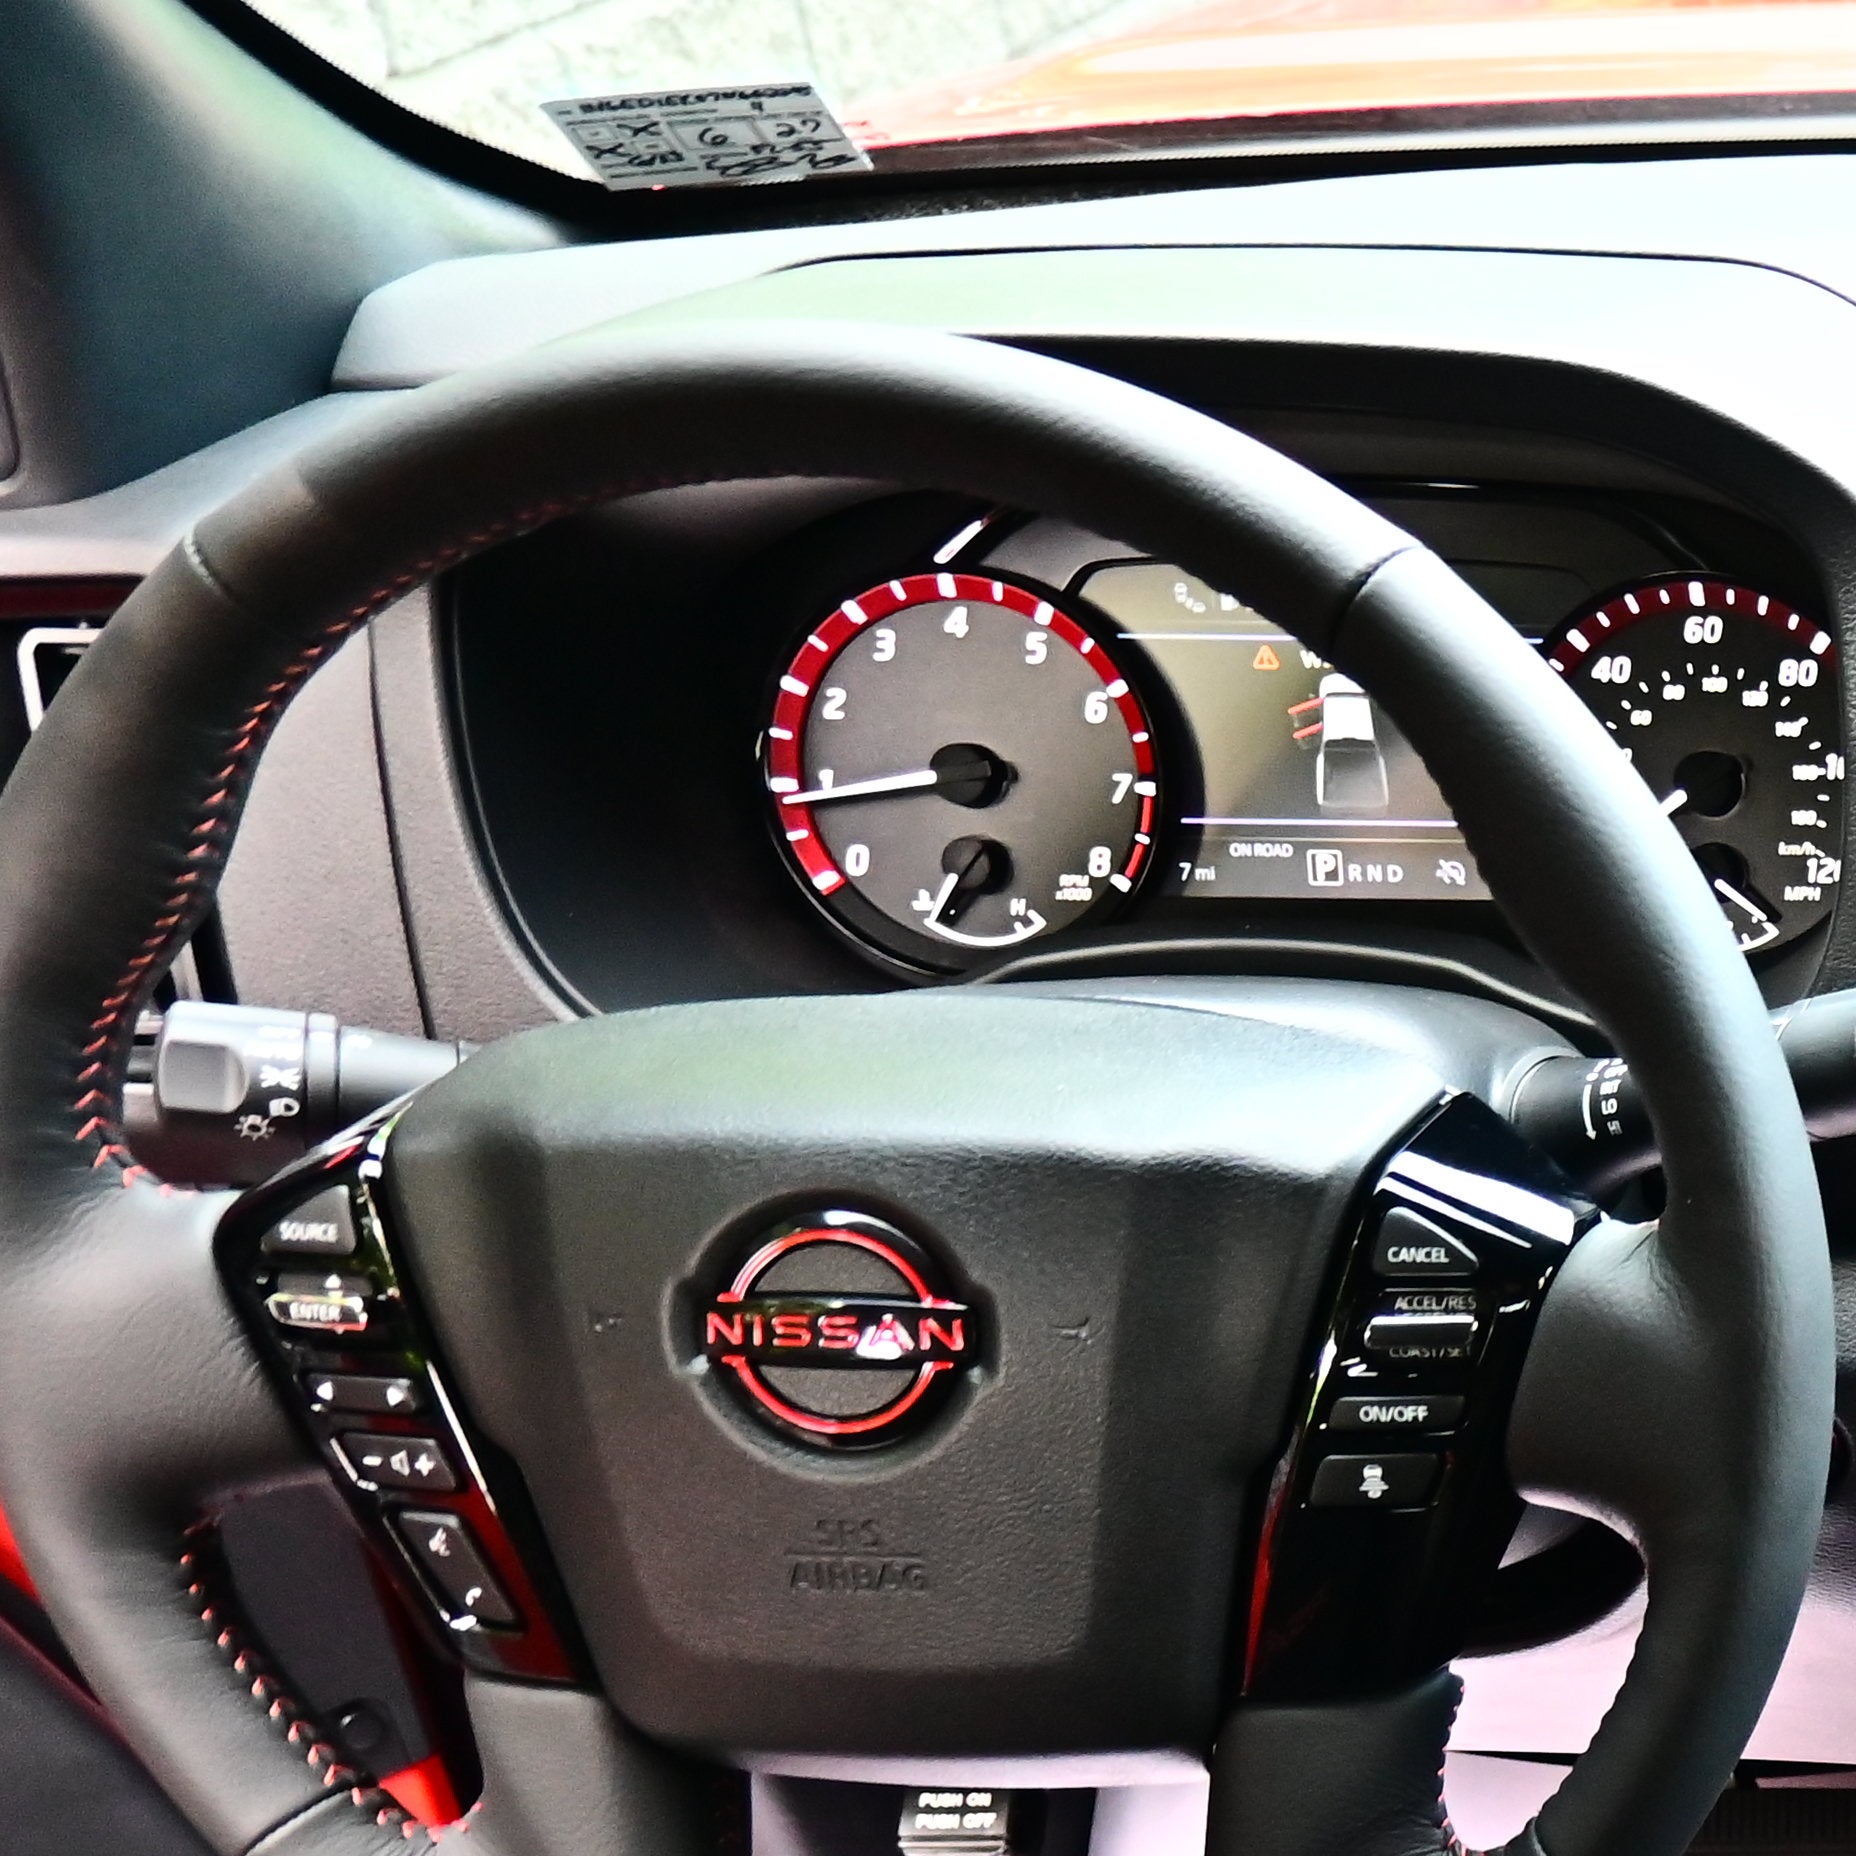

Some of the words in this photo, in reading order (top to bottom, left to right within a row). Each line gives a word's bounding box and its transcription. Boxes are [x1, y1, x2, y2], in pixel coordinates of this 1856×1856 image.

[943, 606, 969, 638] 4
[1684, 616, 1723, 643] 60
[873, 629, 896, 661] 3
[1025, 631, 1047, 664] 5
[1591, 656, 1632, 683] 40
[1778, 659, 1818, 687] 80
[823, 688, 846, 720] 2
[1084, 692, 1108, 723] 6
[1111, 773, 1132, 804] 7
[845, 844, 869, 876] 0
[1089, 847, 1111, 877] 8
[1230, 843, 1252, 858] ON
[1254, 843, 1293, 858] ROAD
[1179, 863, 1191, 882] 7
[1195, 866, 1216, 882] mi
[1313, 852, 1337, 883] P
[1349, 864, 1363, 882] R
[1367, 864, 1382, 882] N
[1389, 864, 1403, 883] D
[1784, 885, 1821, 901] MPH
[1010, 898, 1026, 916] H
[280, 1221, 338, 1243] SOURCE
[1388, 1247, 1449, 1264] CANCEL
[1394, 1296, 1476, 1310] ACCEL/RES
[706, 1312, 965, 1351] NISSAN
[1359, 1405, 1429, 1423] ON/OFF
[919, 1792, 963, 1808] PUSH
[966, 1792, 992, 1807] ON
[915, 1813, 960, 1830] PUSH
[963, 1812, 997, 1829] OFF
